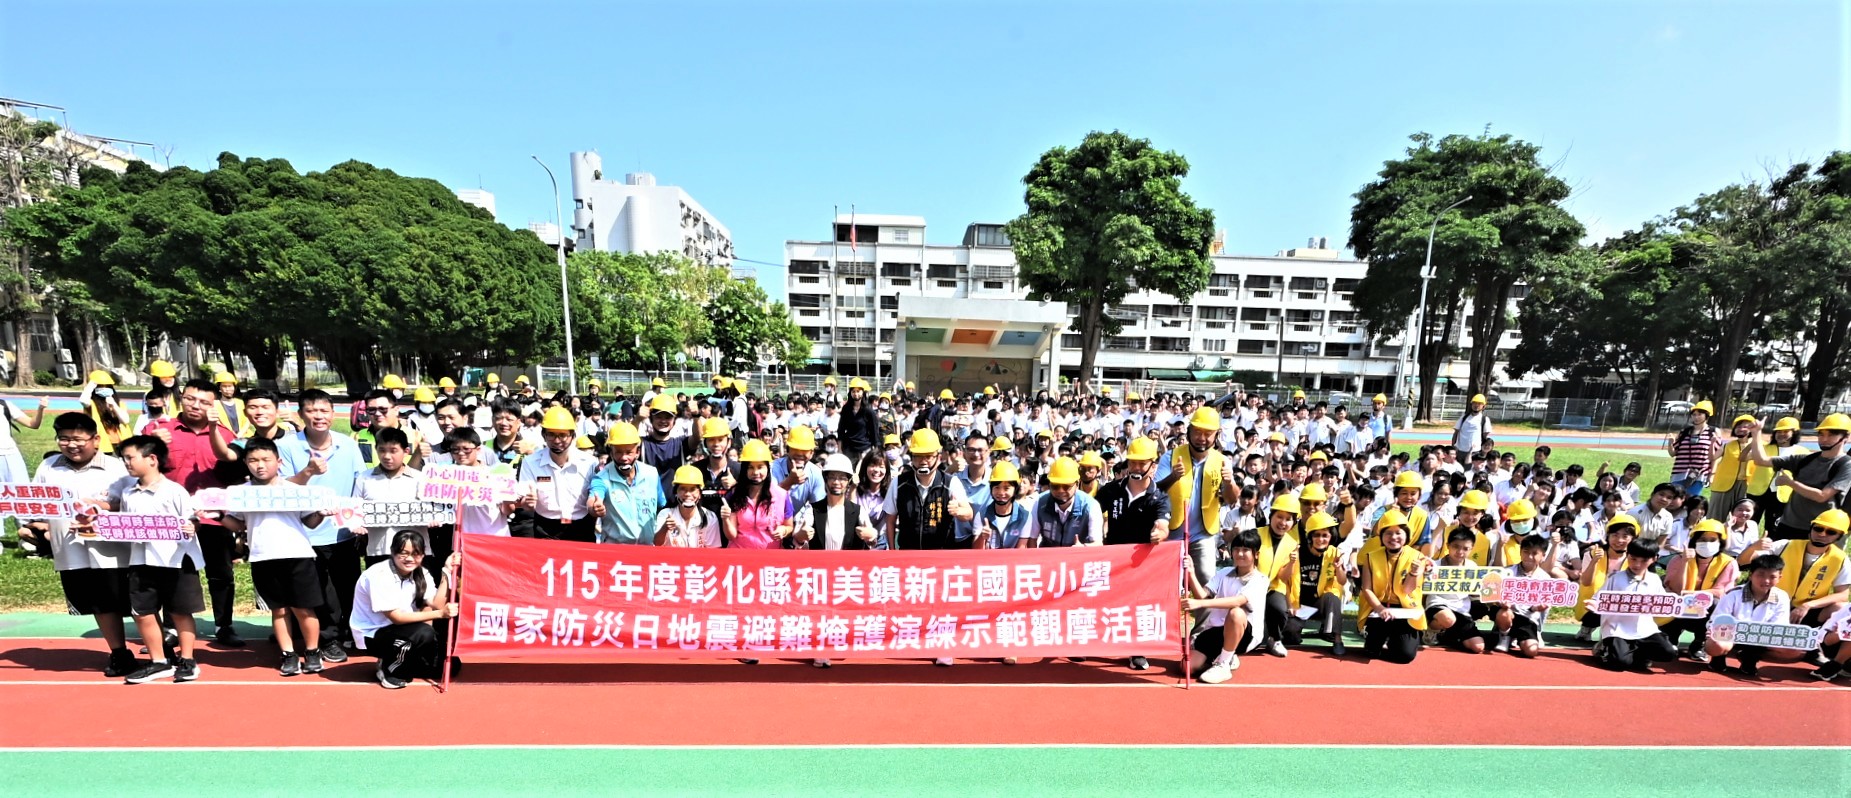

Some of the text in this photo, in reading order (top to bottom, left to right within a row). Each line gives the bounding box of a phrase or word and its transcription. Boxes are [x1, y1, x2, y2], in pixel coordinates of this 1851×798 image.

[541, 558, 1112, 605] 115年度彰化縣和美鎮新庄國民小學
[472, 601, 1167, 652] 國家防災日地震避難掩護演練示範觀摩活動
